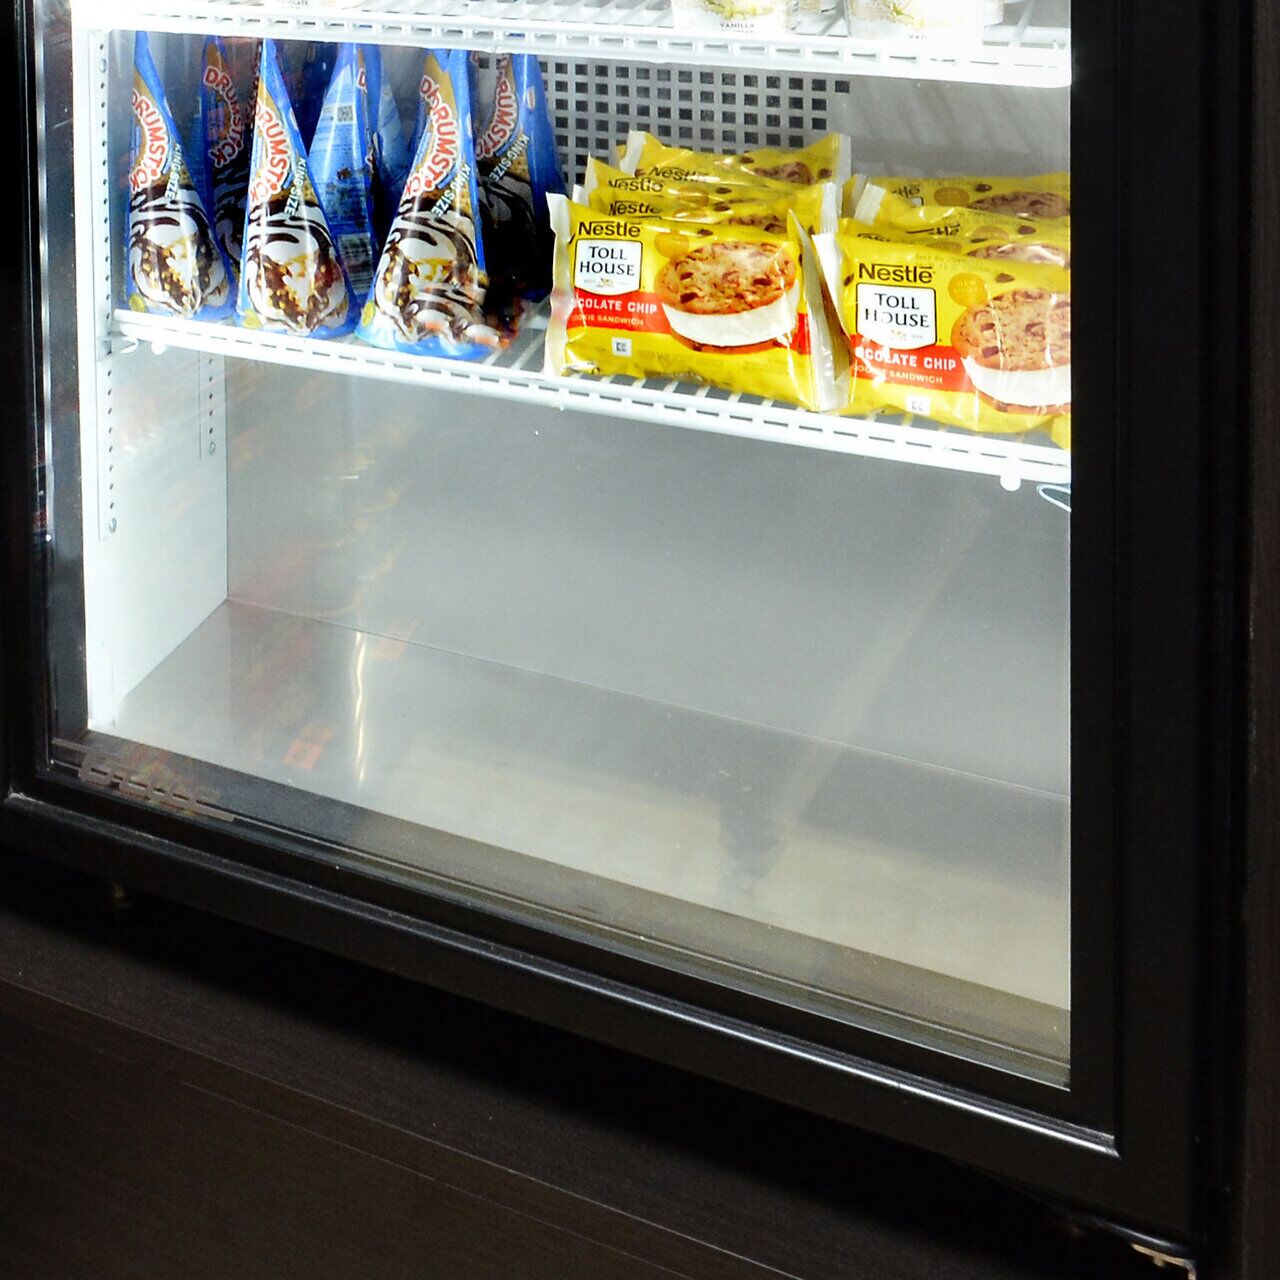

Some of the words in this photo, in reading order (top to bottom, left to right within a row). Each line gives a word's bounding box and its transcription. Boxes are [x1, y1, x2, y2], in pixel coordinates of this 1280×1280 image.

[170, 143, 182, 169] KING
[294, 157, 308, 187] KING
[453, 165, 471, 191] KING
[165, 168, 179, 200] SIZE
[284, 187, 299, 216] SIZE
[431, 187, 454, 218] SIZE
[589, 245, 627, 261] TOLL
[580, 261, 635, 277] HOUSE
[627, 302, 657, 314] CHIP
[875, 293, 920, 310] TOLL
[598, 315, 643, 326] SANDWICH
[865, 308, 930, 328] HOUSE
[924, 357, 957, 371] CHIP
[889, 370, 943, 384] SANDWICH
